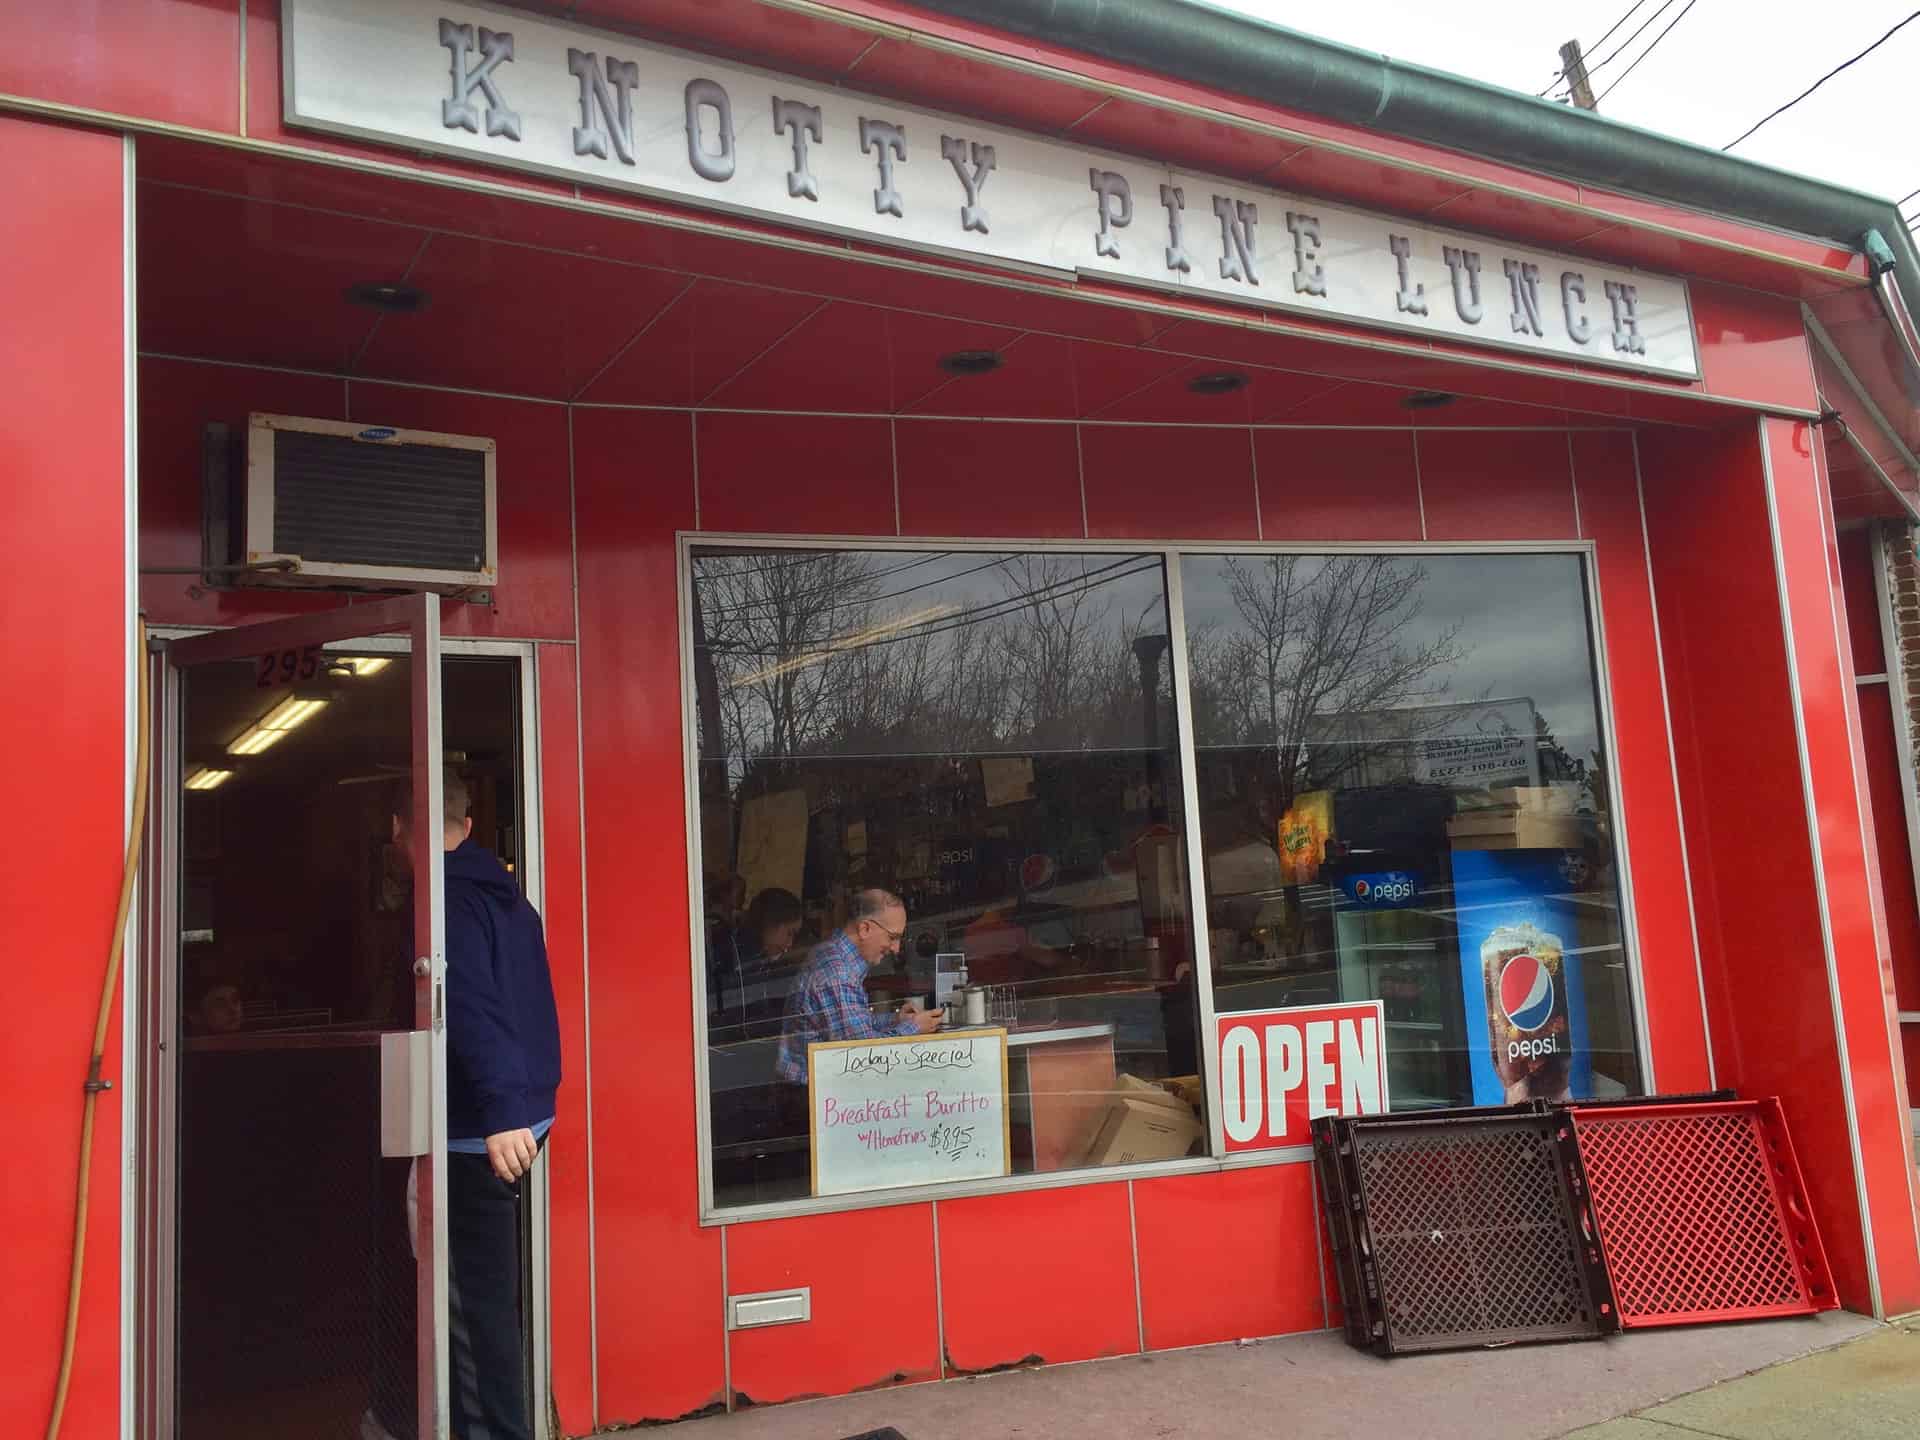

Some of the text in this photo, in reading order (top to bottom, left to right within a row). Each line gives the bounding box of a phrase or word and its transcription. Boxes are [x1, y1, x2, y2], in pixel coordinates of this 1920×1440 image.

[438, 18, 1645, 354] KNOTTY PINE LUNCH
[257, 648, 318, 688] 295
[1374, 880, 1415, 902] pepsi
[842, 1040, 975, 1074] Today's Special
[1508, 1033, 1556, 1063] pepsi
[1221, 1017, 1381, 1142] OPEN
[824, 1095, 912, 1126] Breakfast
